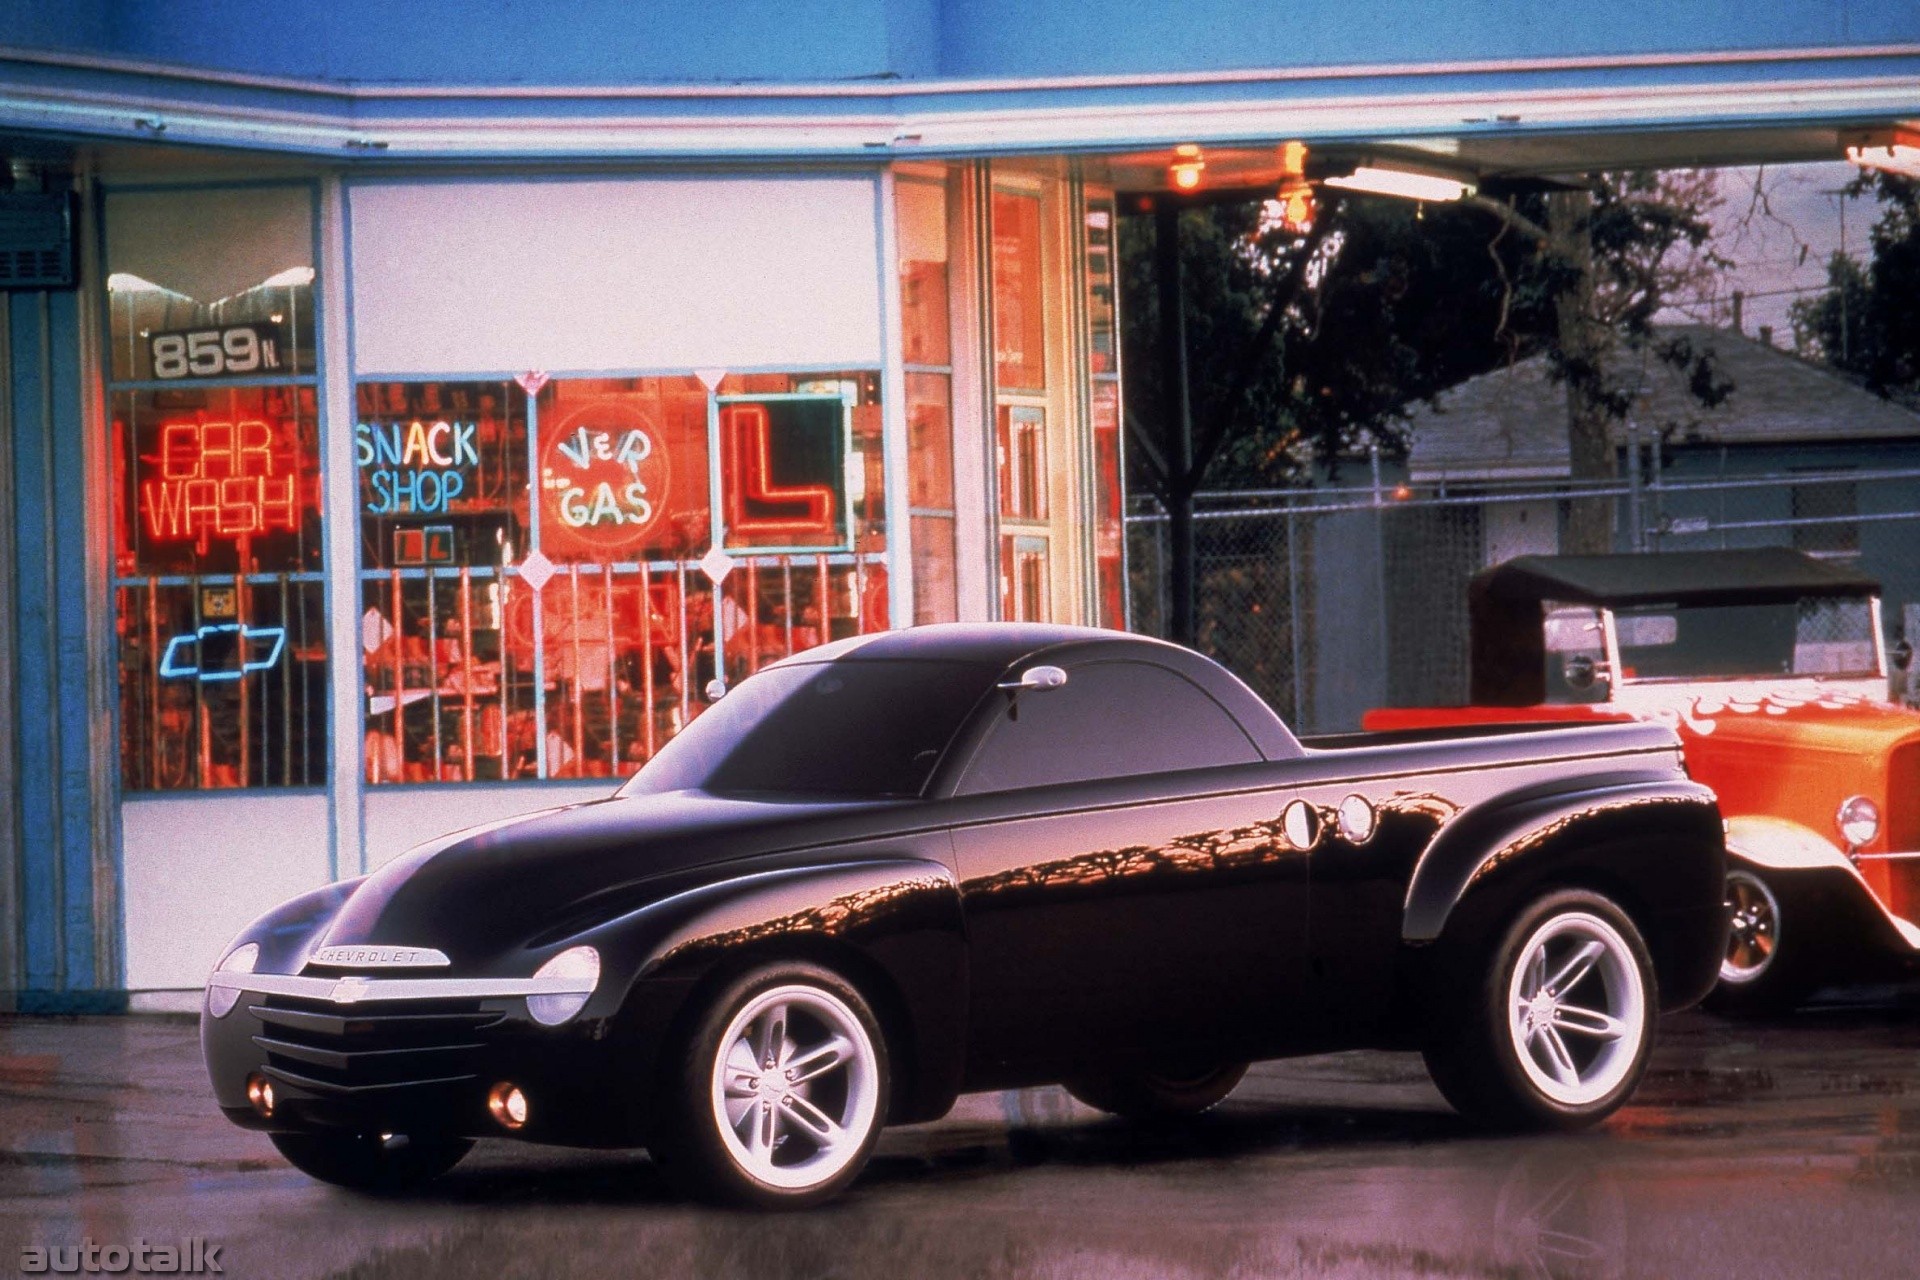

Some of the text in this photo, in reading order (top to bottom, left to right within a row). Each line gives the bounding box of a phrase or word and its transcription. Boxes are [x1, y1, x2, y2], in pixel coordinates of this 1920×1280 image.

[153, 328, 260, 379] 859
[164, 420, 272, 479] CAR
[356, 421, 479, 466] SNACK
[145, 474, 294, 536] WASH
[367, 470, 464, 514] SHOP
[561, 482, 652, 527] GAS
[319, 950, 420, 963] CHEVROLET
